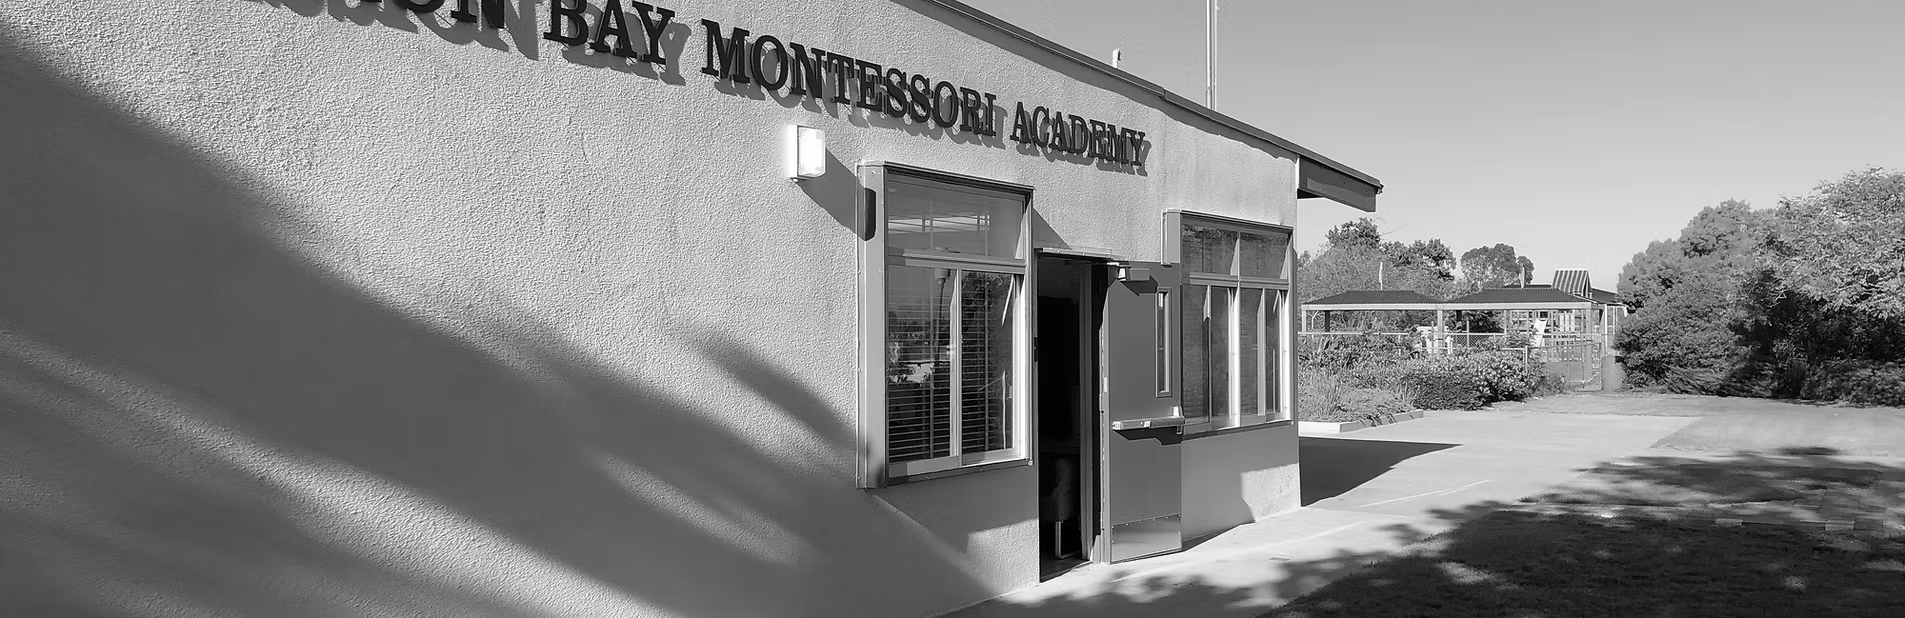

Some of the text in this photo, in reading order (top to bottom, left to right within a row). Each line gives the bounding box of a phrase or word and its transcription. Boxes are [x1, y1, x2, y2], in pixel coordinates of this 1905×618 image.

[543, 0, 675, 65] BAY
[701, 19, 996, 137] MONTESSORI
[1010, 101, 1145, 166] ACADEMY
